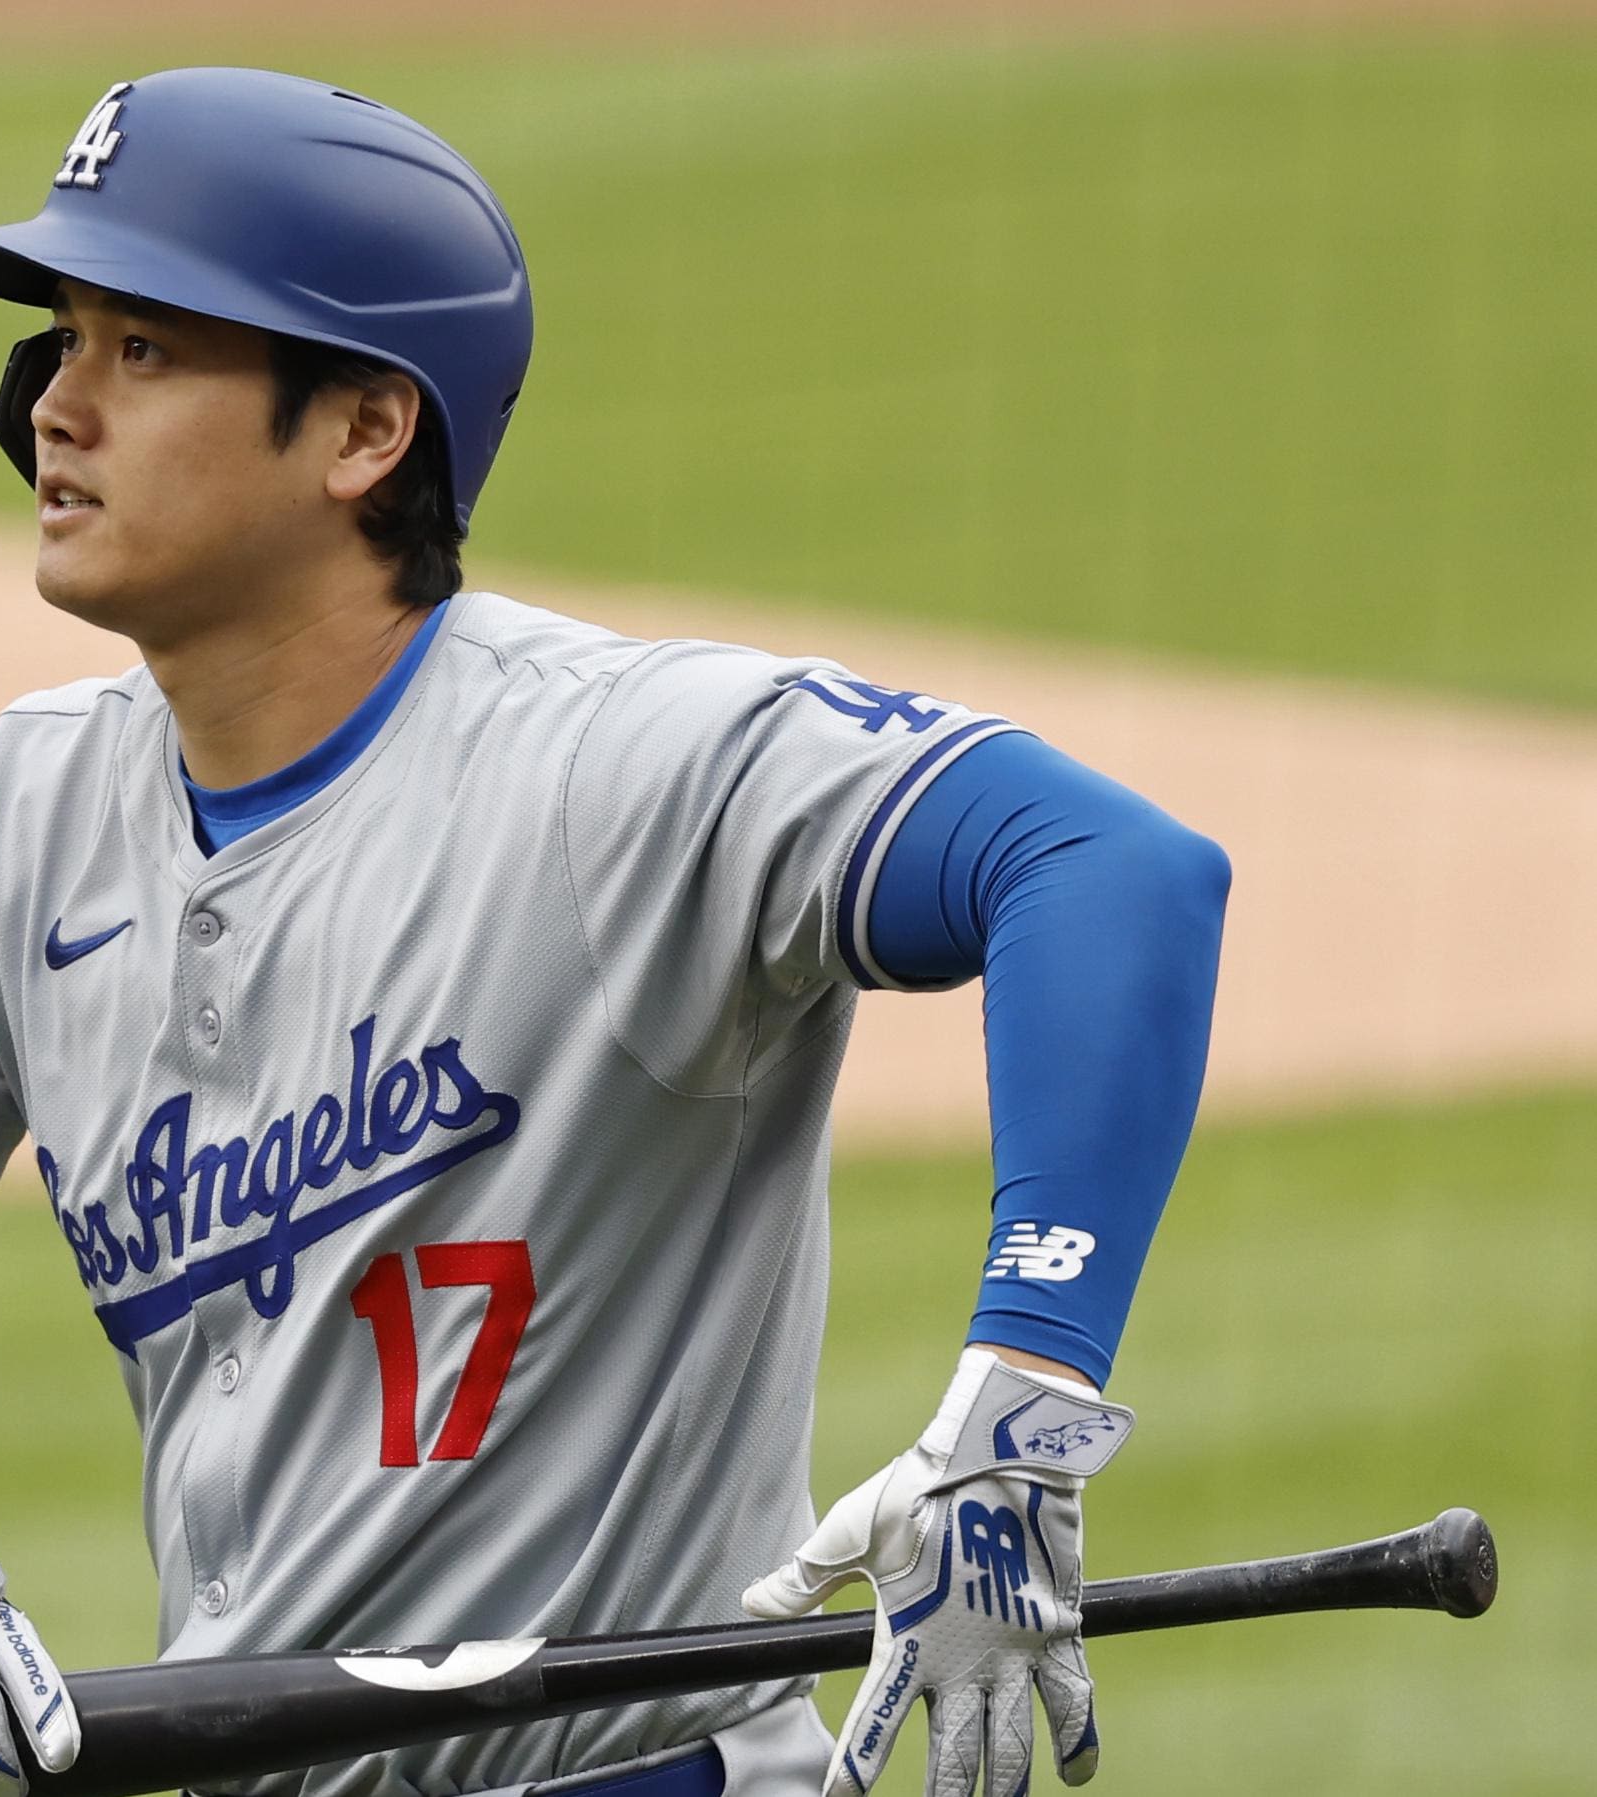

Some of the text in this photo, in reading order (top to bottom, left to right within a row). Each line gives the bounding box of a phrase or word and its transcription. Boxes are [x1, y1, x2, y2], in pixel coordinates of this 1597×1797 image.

[54, 81, 133, 190] LA
[124, 1013, 498, 1319] Angeles
[349, 1238, 538, 1469] 17
[7, 1634, 49, 1697] balance
[857, 1637, 920, 1761] new balance
